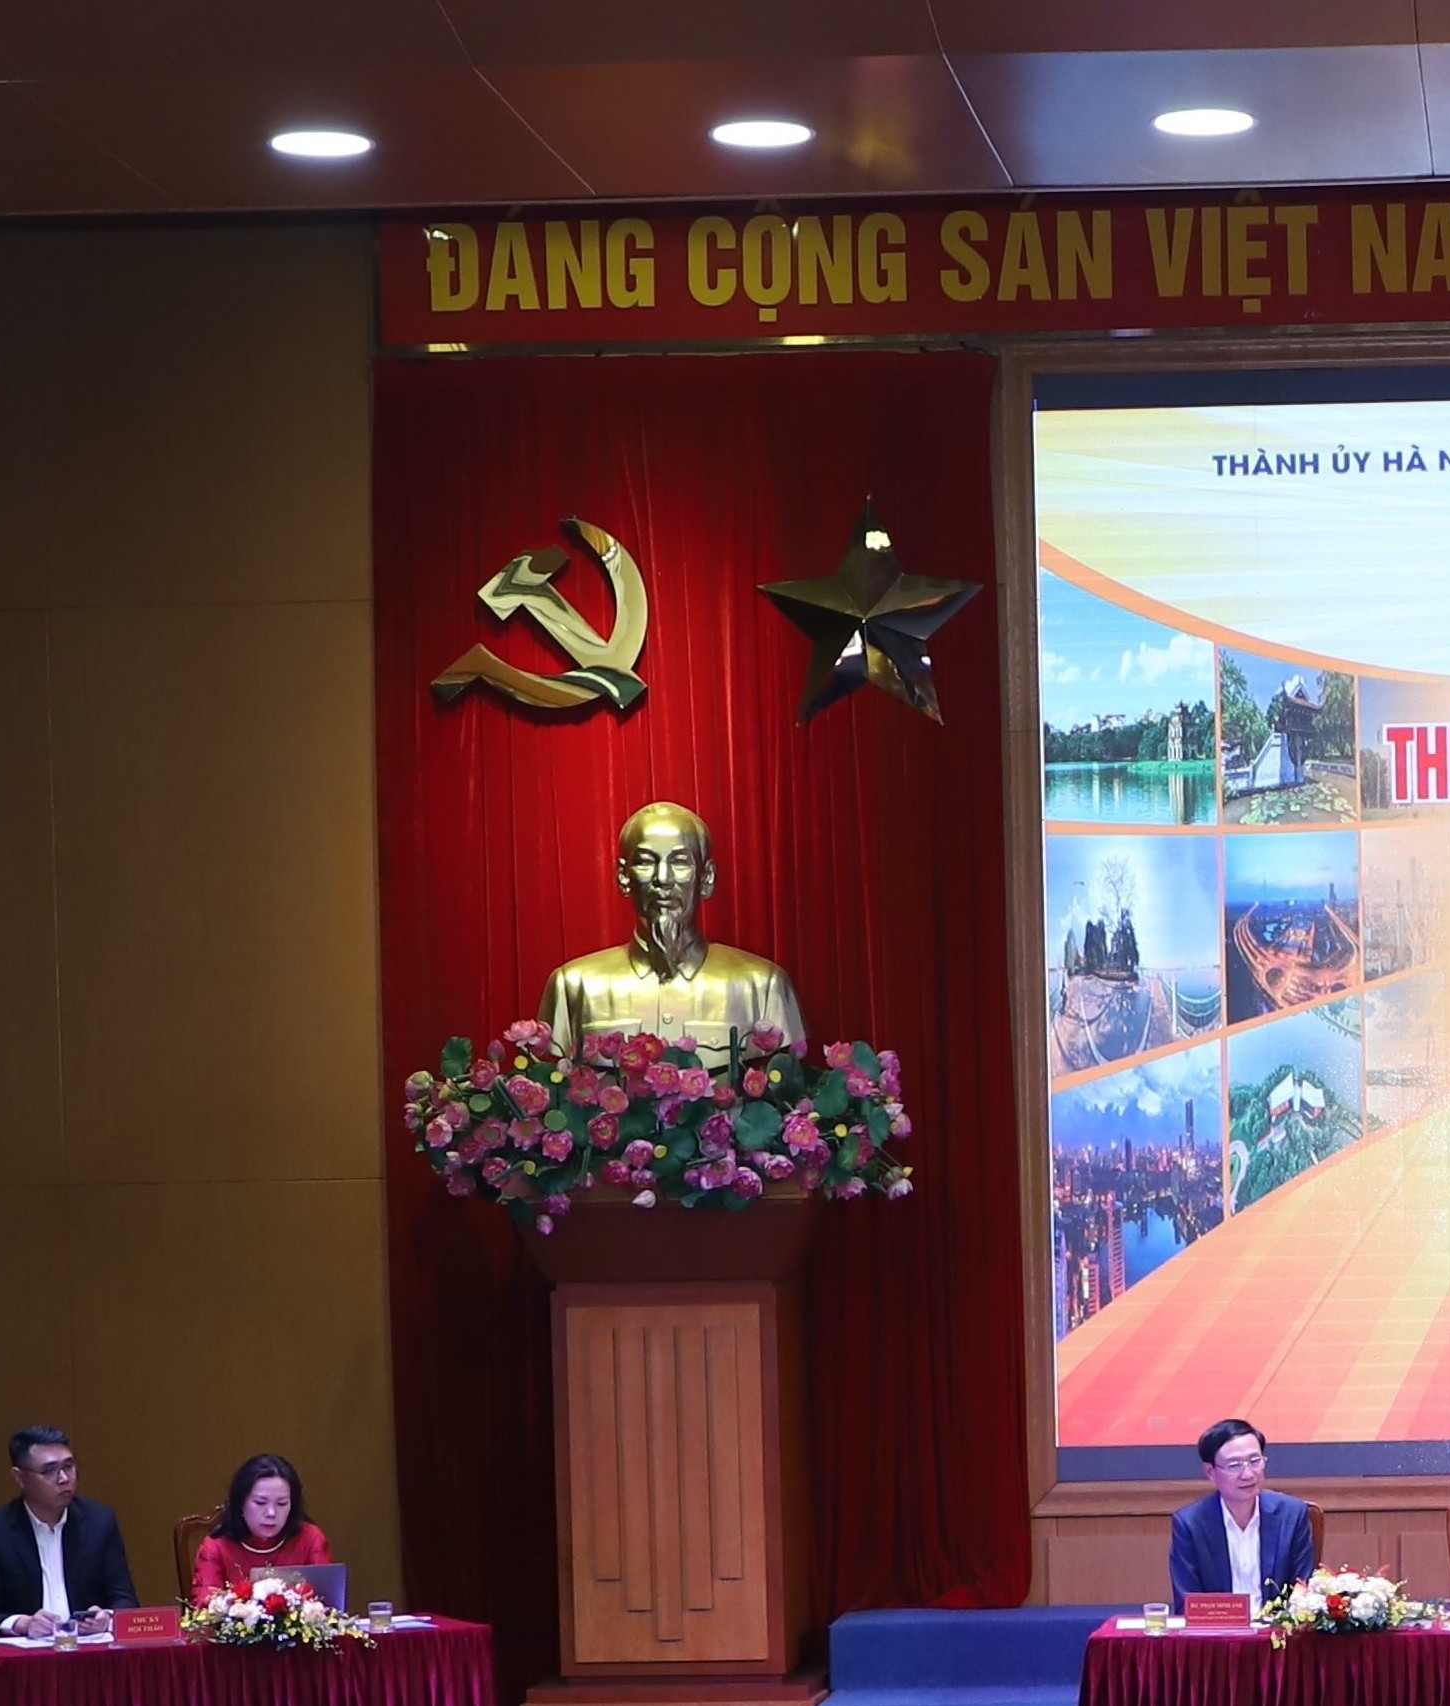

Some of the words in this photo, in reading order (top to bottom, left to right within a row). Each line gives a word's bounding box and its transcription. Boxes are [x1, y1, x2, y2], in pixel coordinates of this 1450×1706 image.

[426, 203, 655, 311] ĐẢNG
[687, 202, 908, 322] CỘNG
[940, 191, 1113, 300] SẢN
[1145, 187, 1318, 313] VIỆT
[1213, 448, 1319, 477] THÀNH
[1331, 444, 1370, 475] ỦY
[1383, 444, 1426, 473] HÀ
